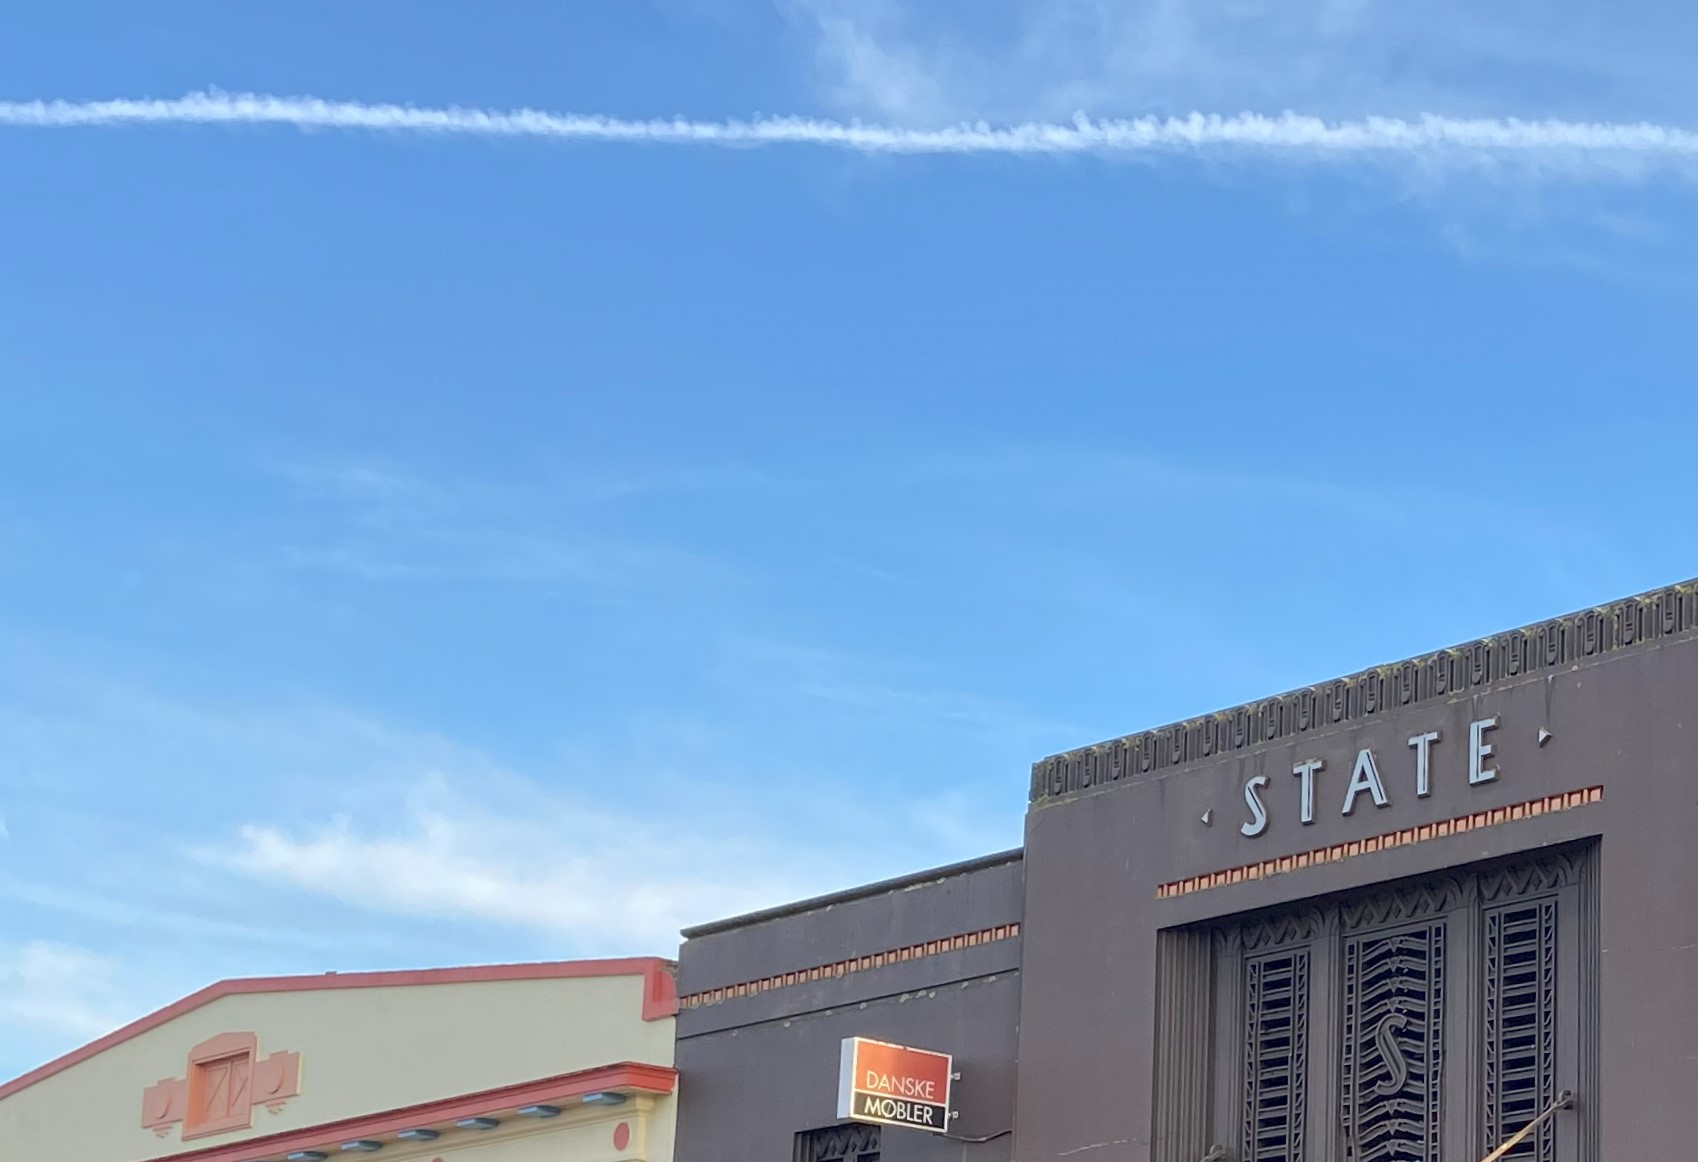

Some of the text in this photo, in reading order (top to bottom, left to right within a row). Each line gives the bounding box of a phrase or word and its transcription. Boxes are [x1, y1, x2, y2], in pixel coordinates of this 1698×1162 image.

[1240, 716, 1501, 837] STATE
[866, 1070, 935, 1099] DANSKE
[864, 1096, 933, 1124] MØBLER
